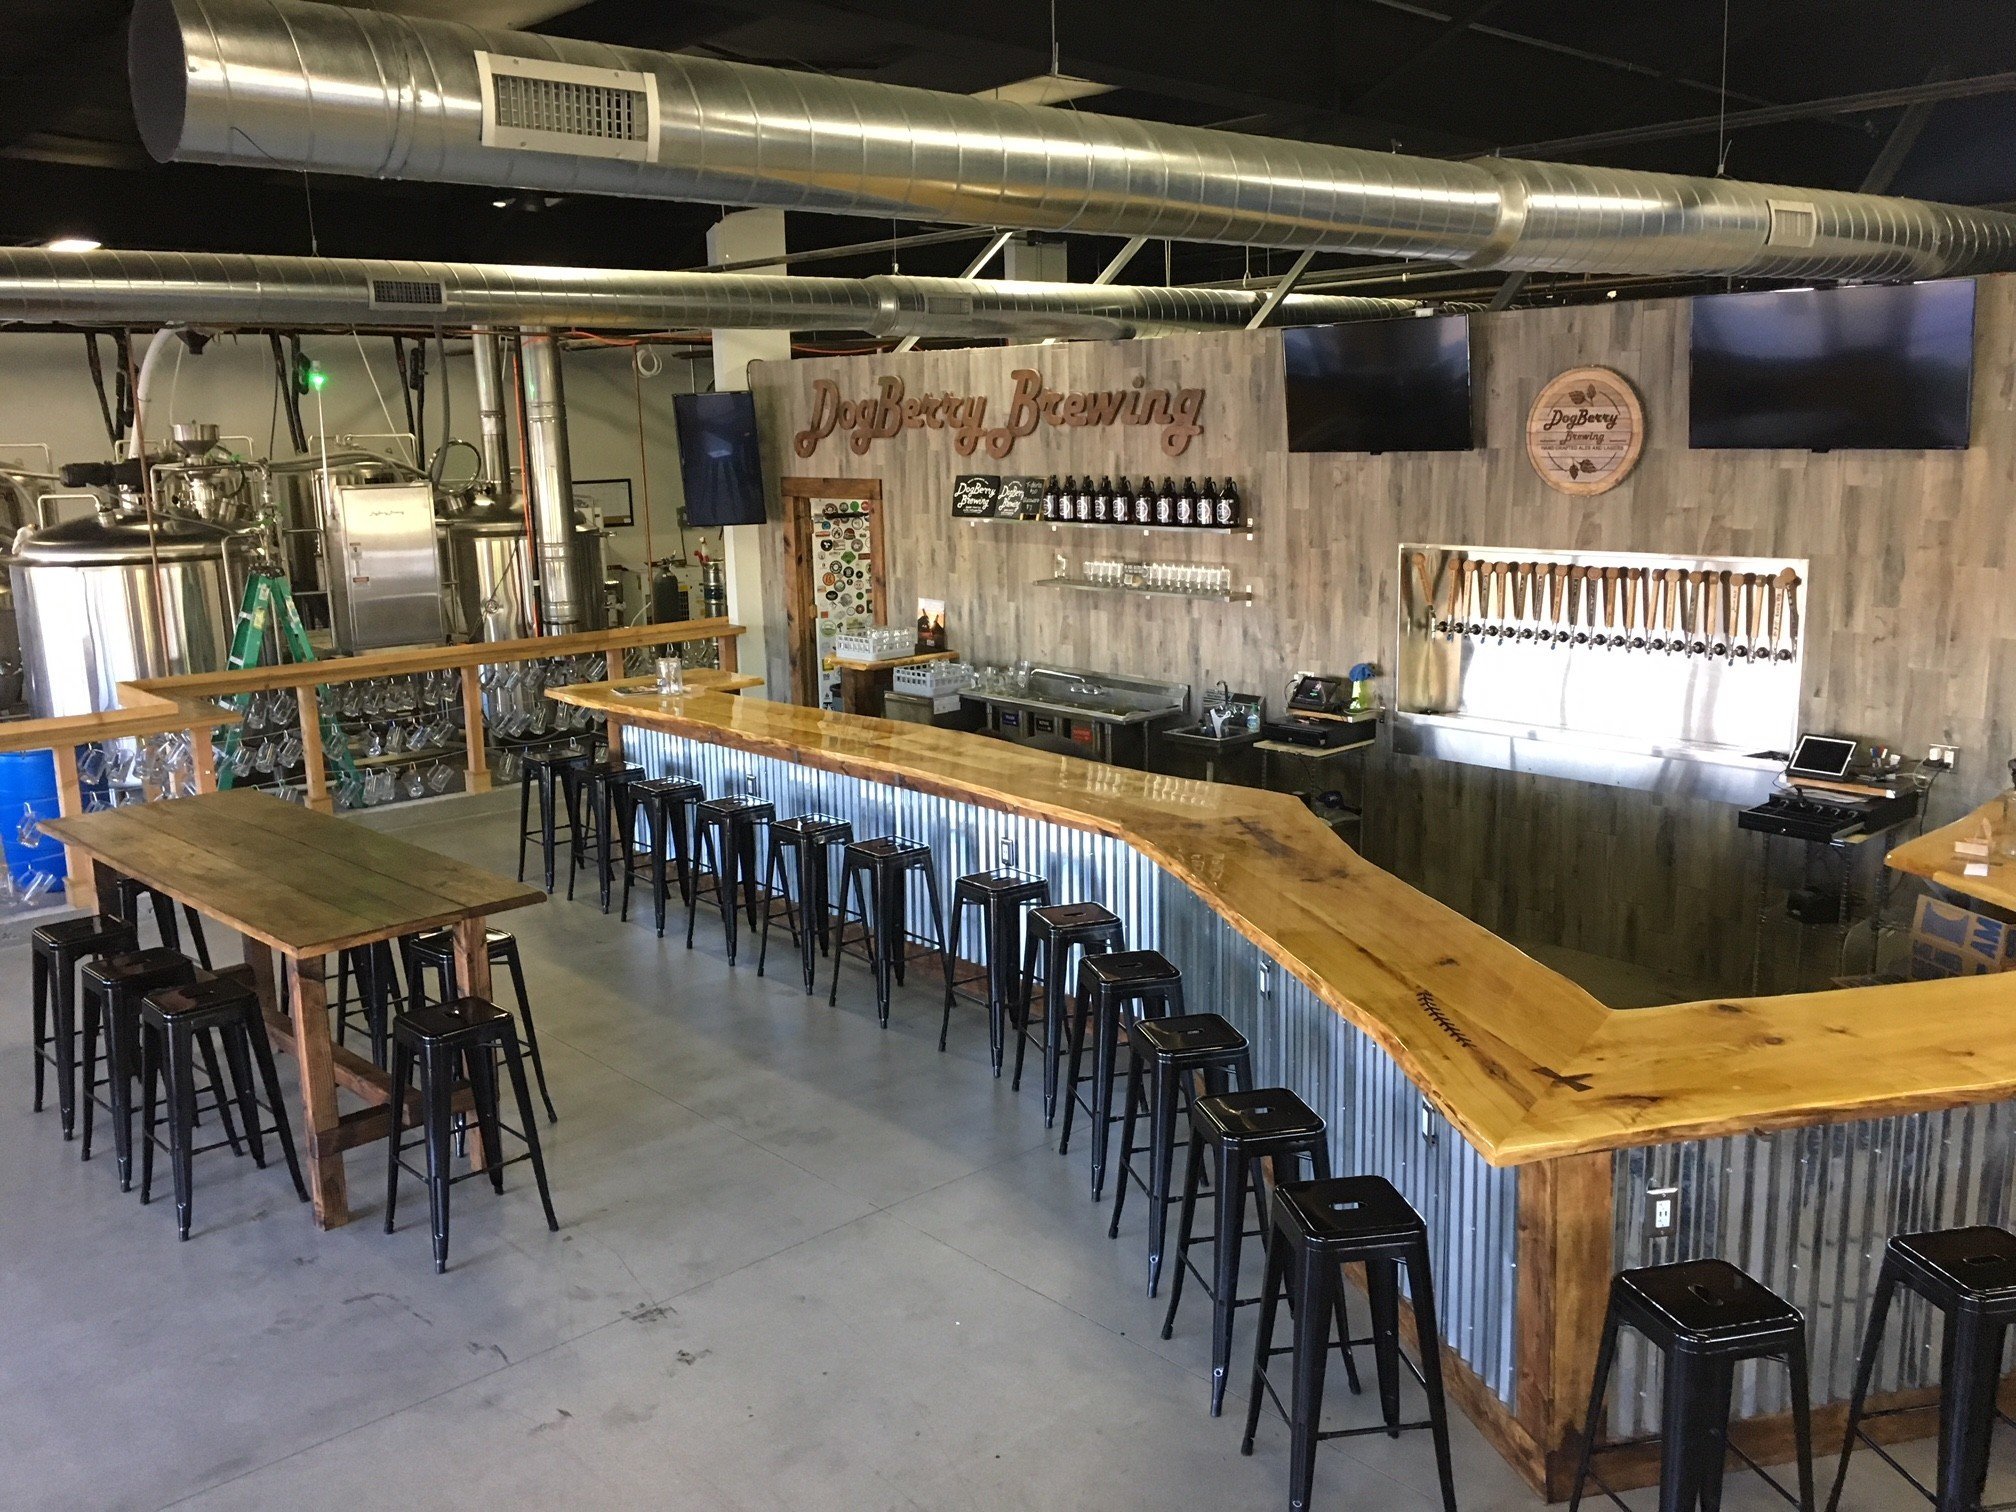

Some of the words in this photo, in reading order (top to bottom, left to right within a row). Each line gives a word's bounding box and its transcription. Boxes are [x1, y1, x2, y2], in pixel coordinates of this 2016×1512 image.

[794, 374, 987, 458] DogBerry
[985, 368, 1205, 459] Brewing
[1543, 409, 1618, 431] DogBerry
[1559, 430, 1605, 445] Brewing
[954, 482, 996, 498] DogBerry
[957, 494, 990, 511] Brewing
